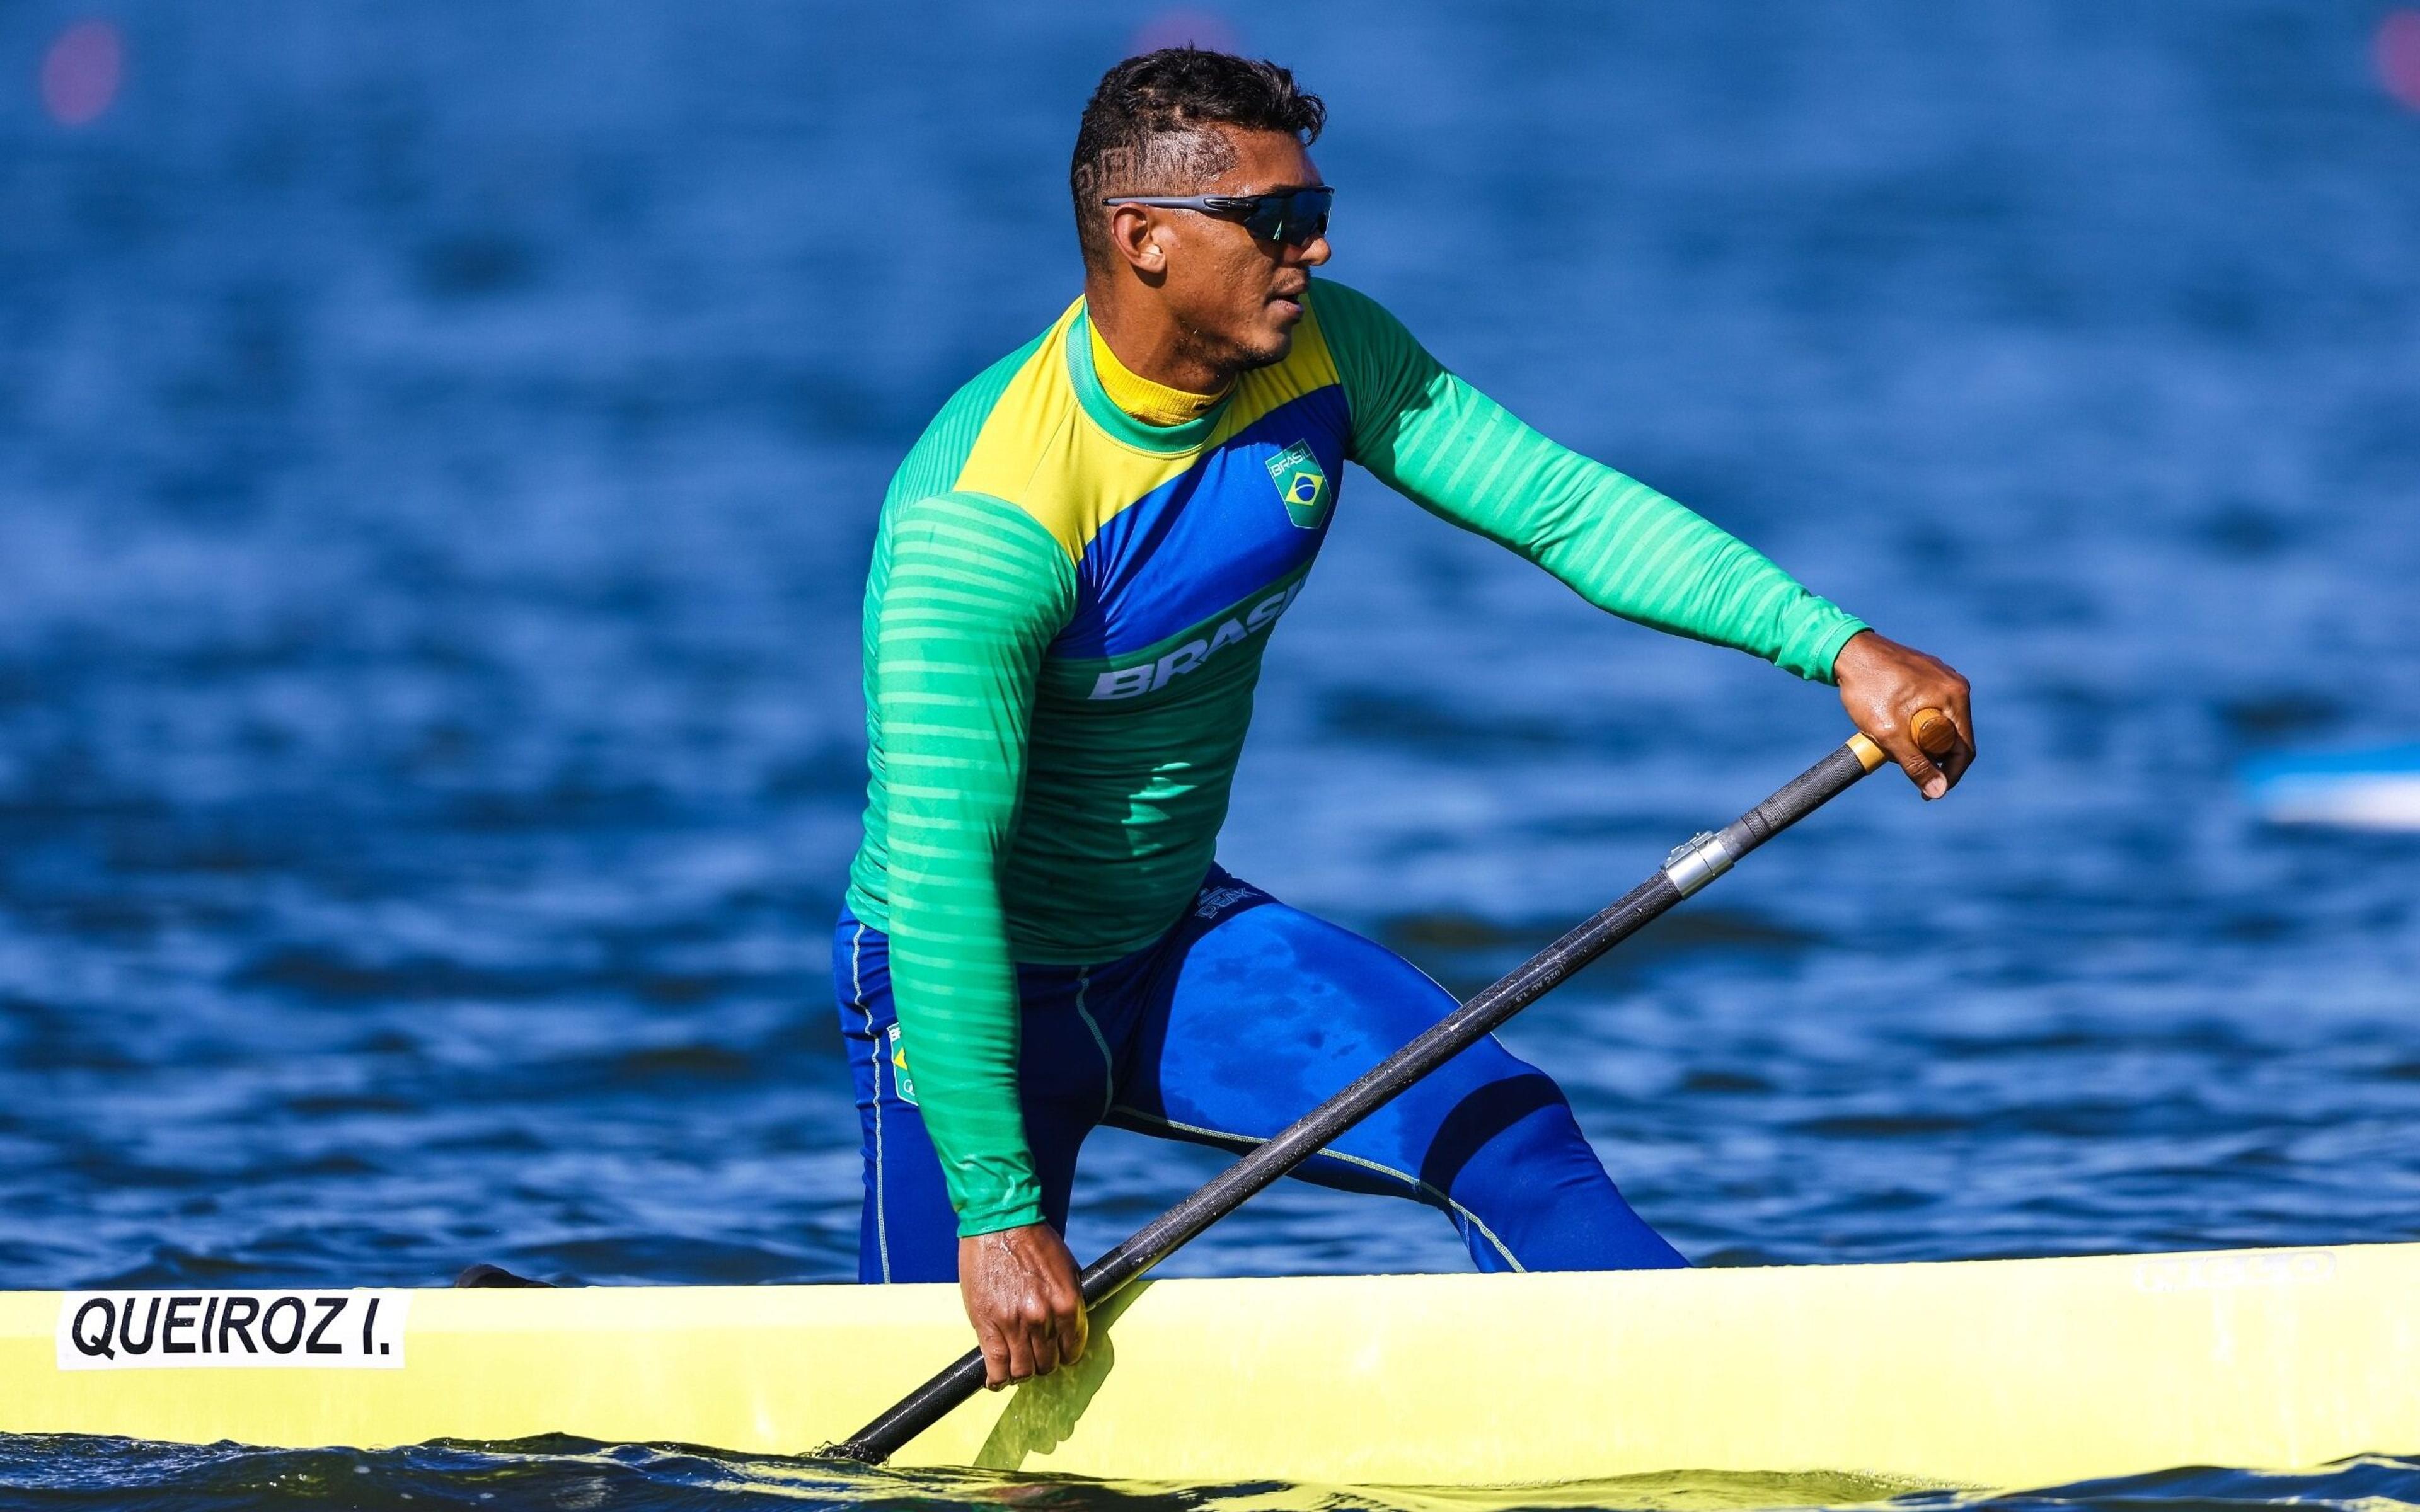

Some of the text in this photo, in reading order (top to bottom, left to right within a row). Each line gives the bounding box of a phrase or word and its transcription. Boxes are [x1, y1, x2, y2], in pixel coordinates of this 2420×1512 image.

[1270, 448, 1311, 477] BRASIL
[1087, 574, 1306, 701] BRASI
[71, 1296, 390, 1360] QUEIROZ I.
